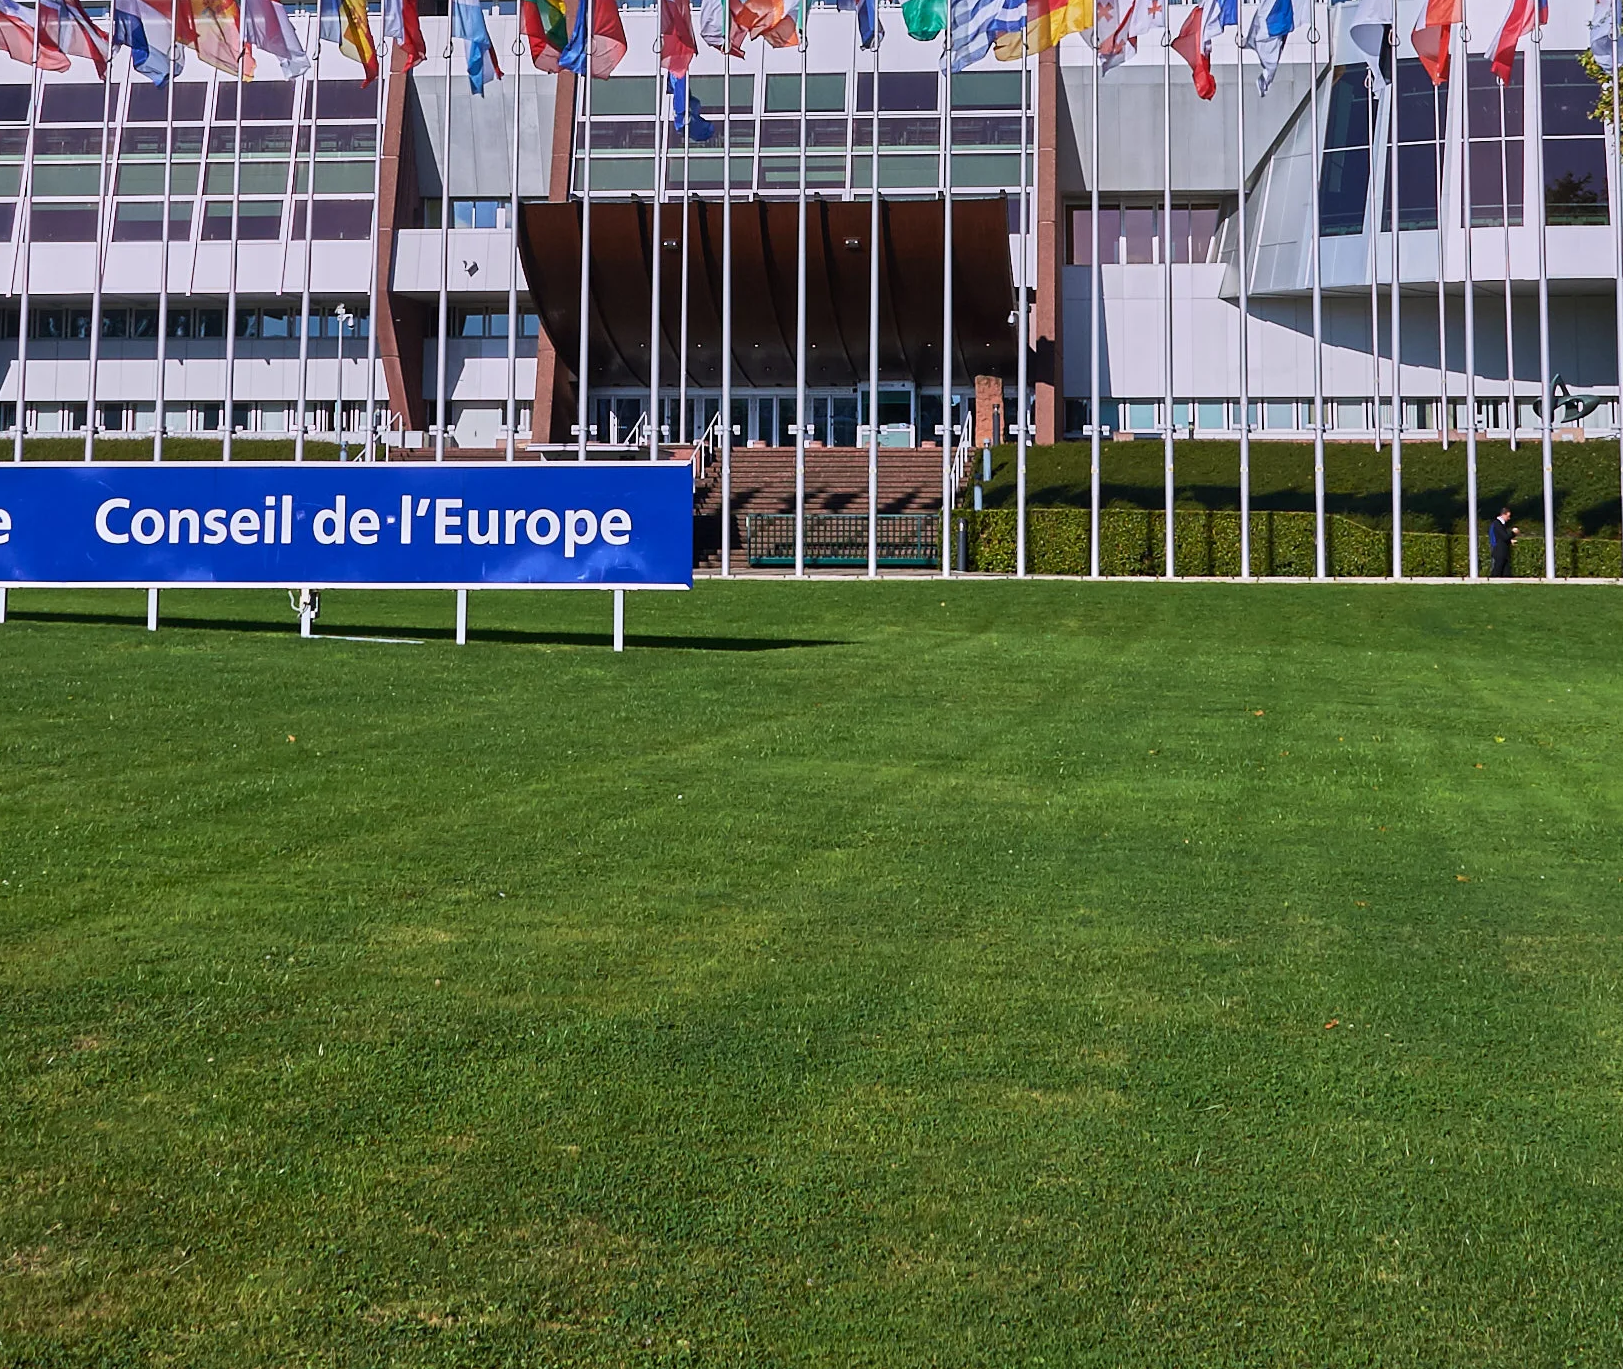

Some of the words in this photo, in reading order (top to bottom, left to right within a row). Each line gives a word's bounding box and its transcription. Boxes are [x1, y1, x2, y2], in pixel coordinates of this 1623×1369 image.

[95, 494, 293, 545] Conseil
[312, 494, 381, 545] de
[400, 494, 632, 558] l'Europe
